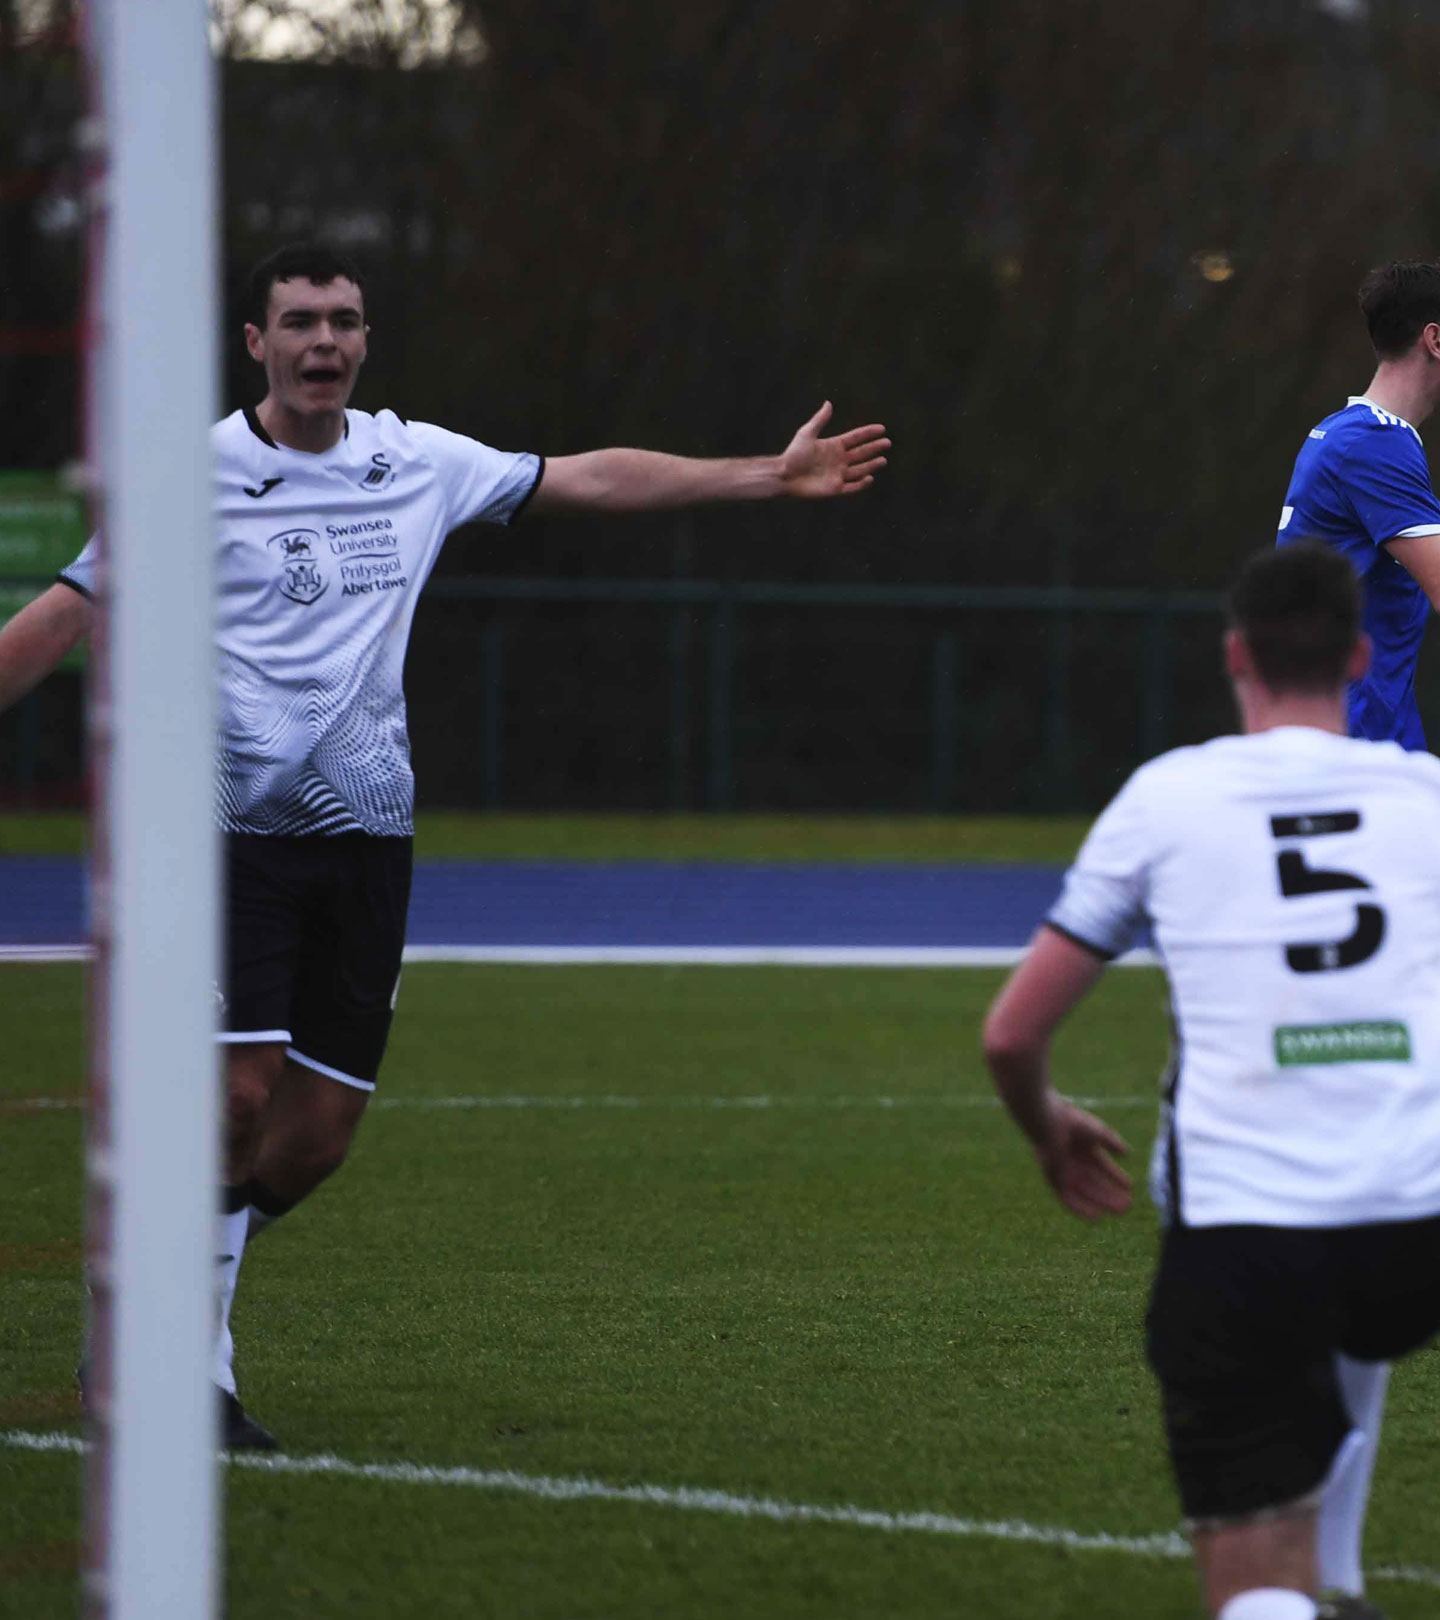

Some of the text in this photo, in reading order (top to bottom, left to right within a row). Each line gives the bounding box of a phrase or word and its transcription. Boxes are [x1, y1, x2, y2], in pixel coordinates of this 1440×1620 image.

[326, 519, 392, 539] Swansea
[330, 533, 398, 555] University
[342, 577, 407, 596] Abertawe
[1270, 811, 1386, 974] 5
